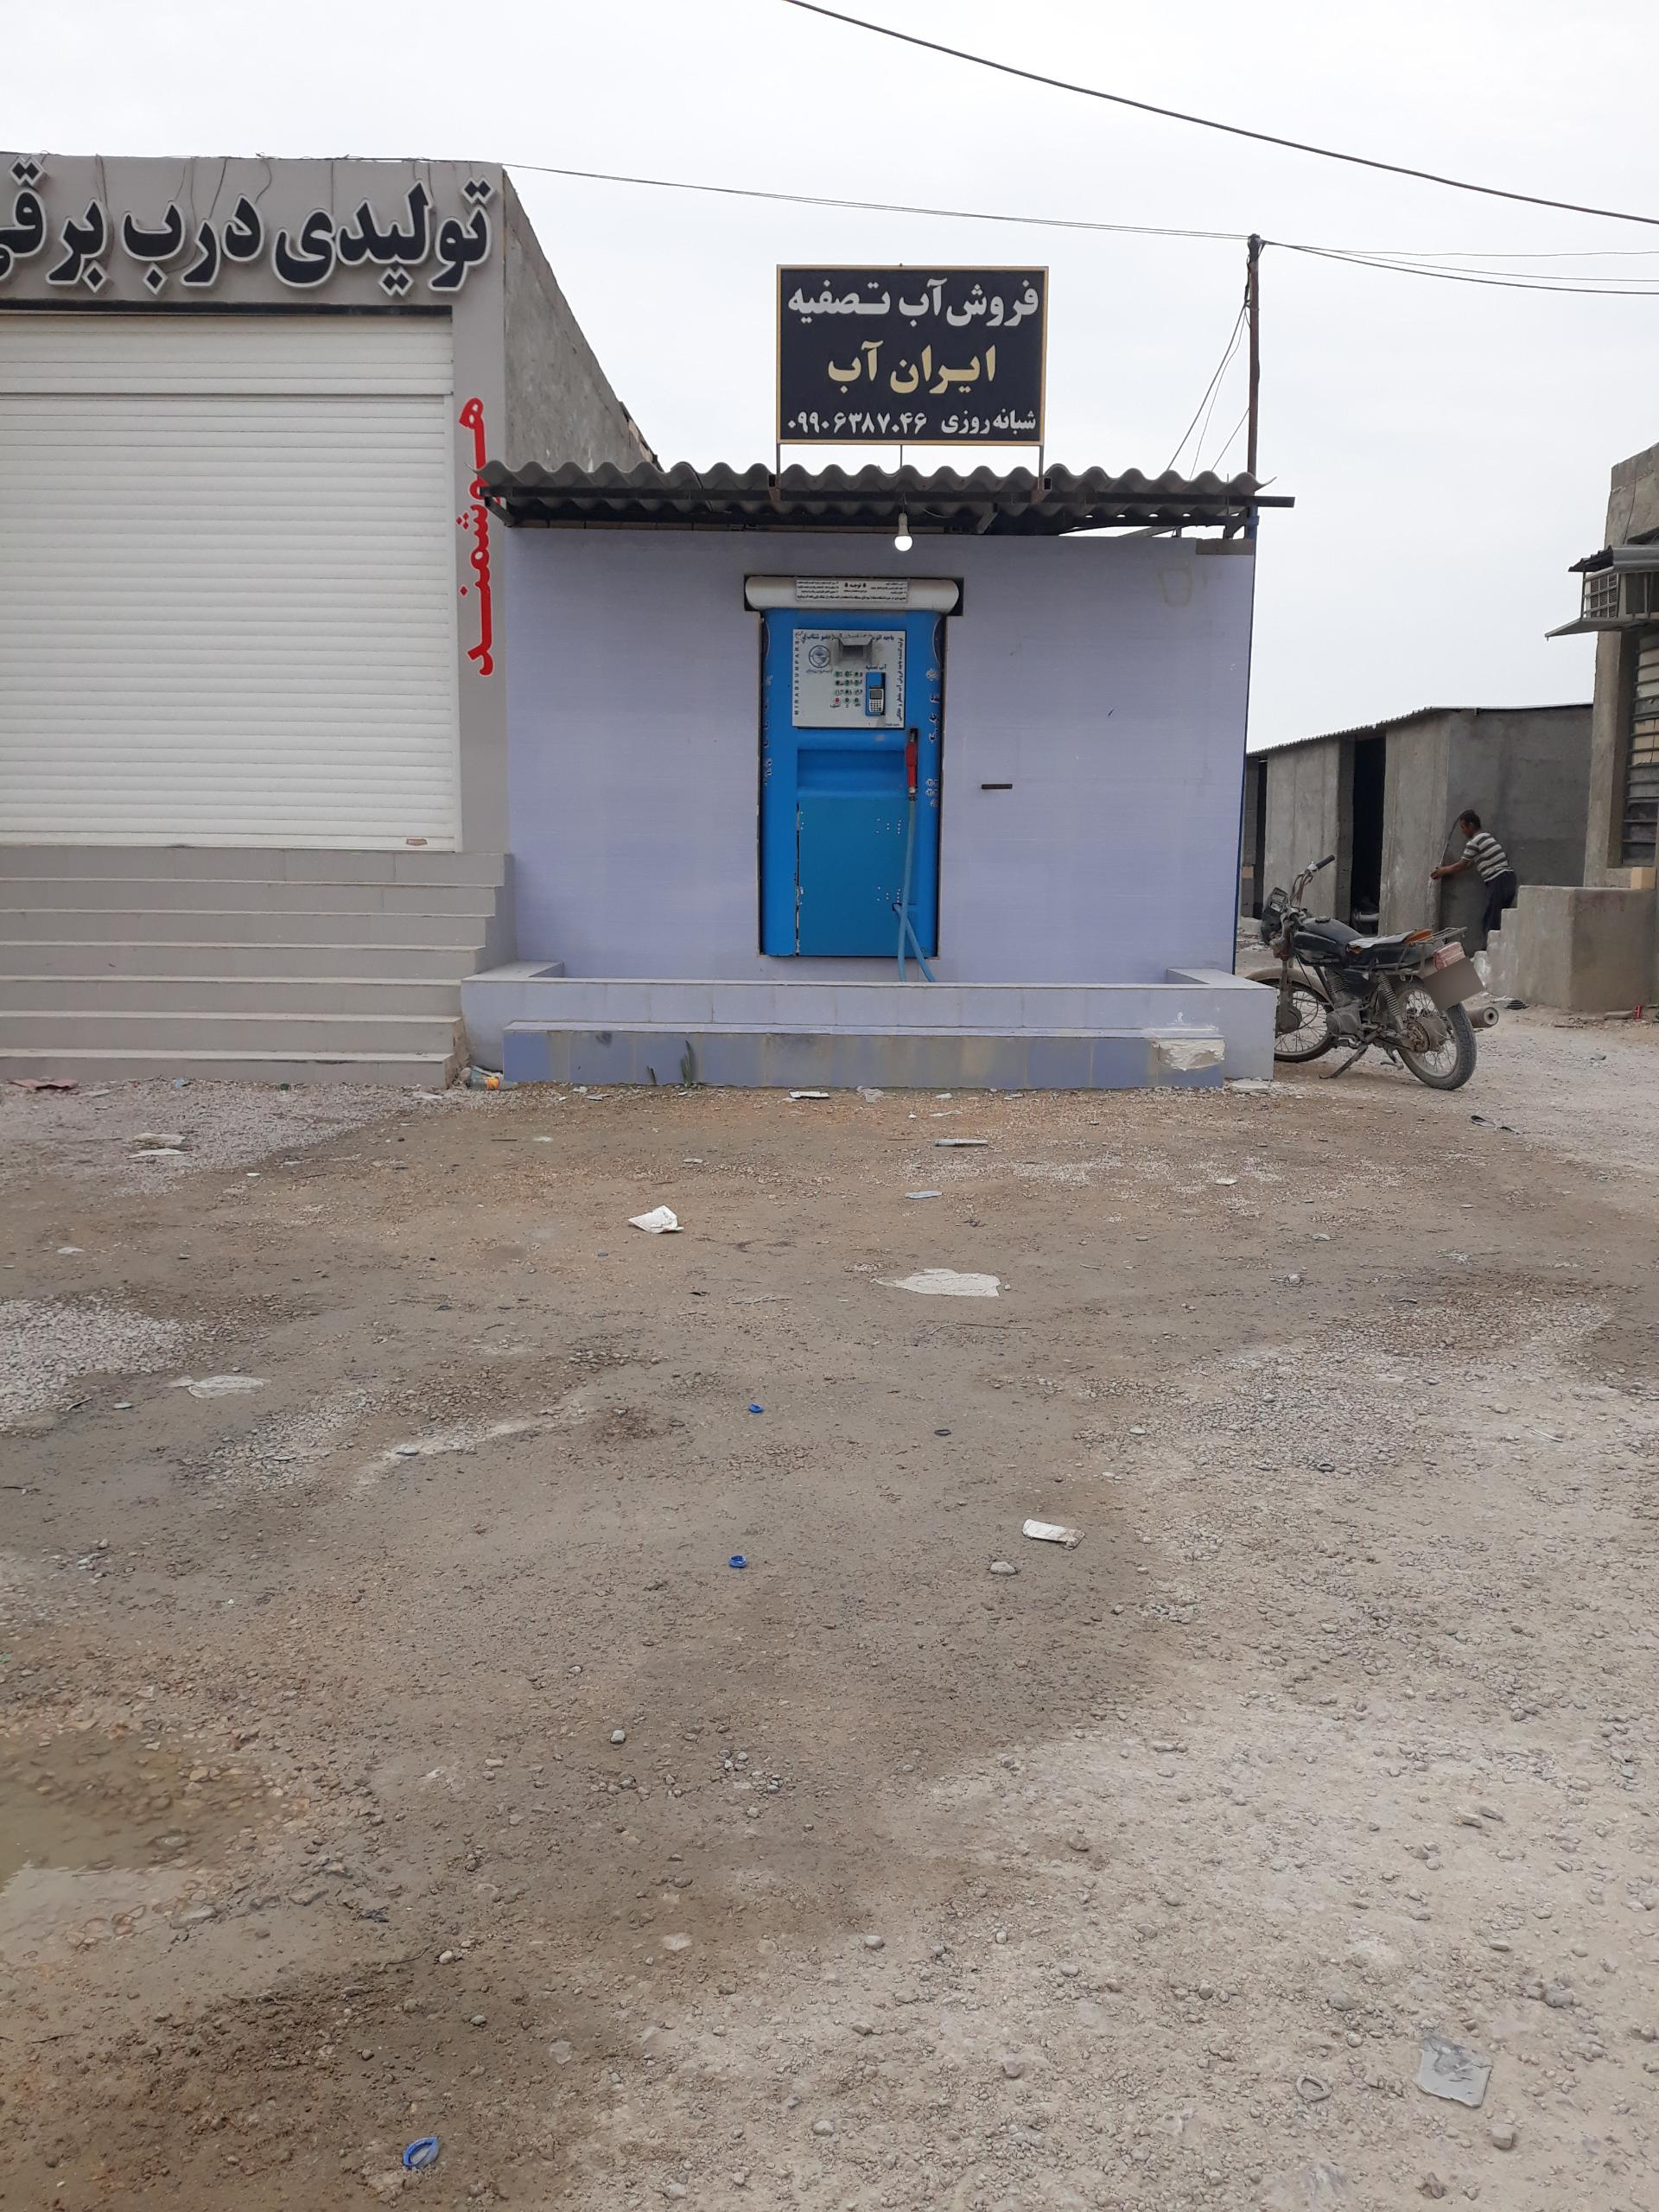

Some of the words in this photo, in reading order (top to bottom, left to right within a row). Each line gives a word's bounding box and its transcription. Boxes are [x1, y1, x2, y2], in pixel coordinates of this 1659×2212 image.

[120, 193, 264, 296] درب
[270, 175, 494, 296] تولیدی
[787, 279, 891, 324] تصفیه
[899, 277, 948, 327] آب
[945, 279, 1039, 327] فروش
[827, 340, 884, 394] آب
[890, 344, 997, 394] ایران
[787, 410, 927, 435] ۰۹۹۰۶۳۸۷۰۴۶
[941, 410, 990, 435] روزی
[992, 409, 1036, 435] شبانه
